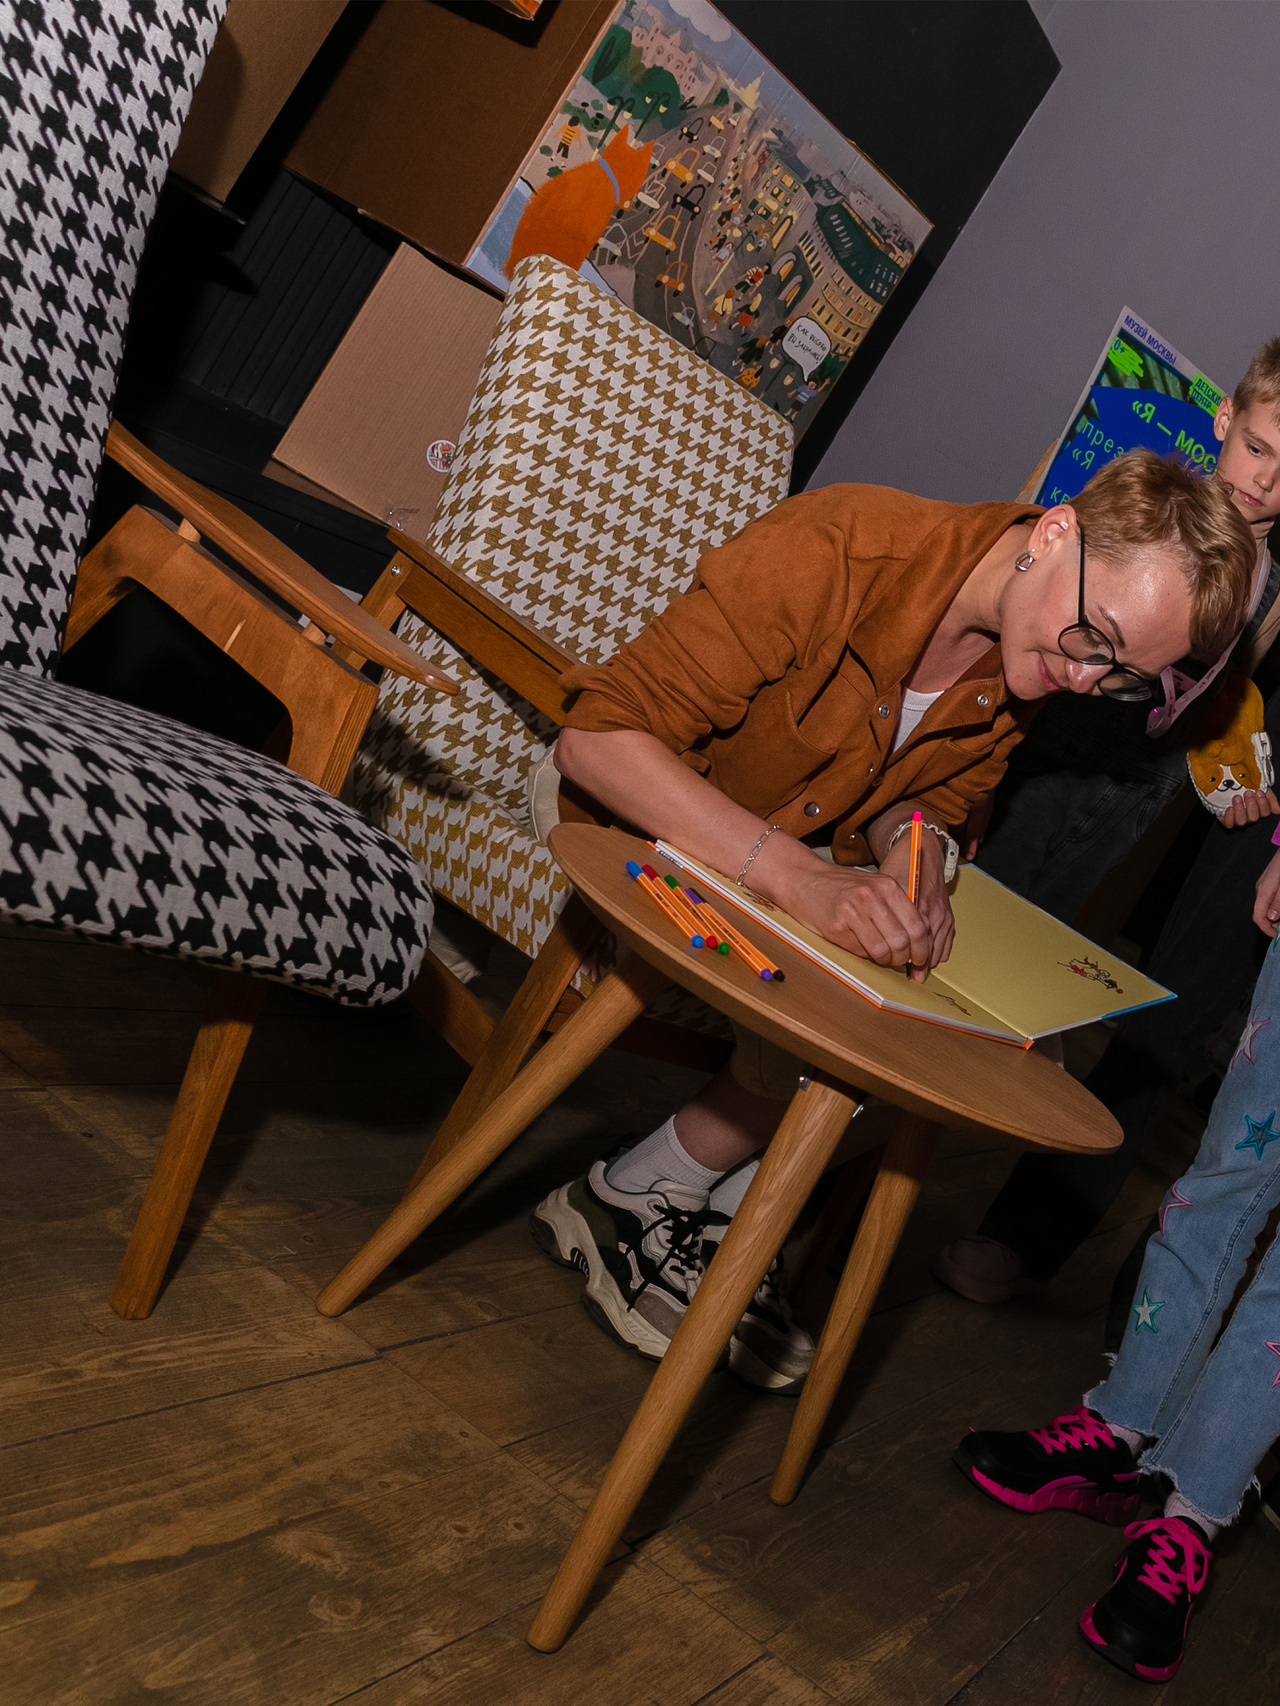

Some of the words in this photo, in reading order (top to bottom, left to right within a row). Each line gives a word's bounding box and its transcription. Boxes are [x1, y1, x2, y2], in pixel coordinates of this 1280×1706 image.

[1113, 339, 1125, 354] 0+
[1124, 315, 1148, 340] МУЗЕЙ
[1146, 334, 1177, 365] МОСКВЫ
[1191, 389, 1212, 409] ЦЕНТР
[1195, 378, 1223, 406] ДЕТСКИ
[1081, 421, 1124, 459] през
[1132, 400, 1156, 424] «Я
[1174, 429, 1217, 475] МОС
[1072, 447, 1096, 470] «Я
